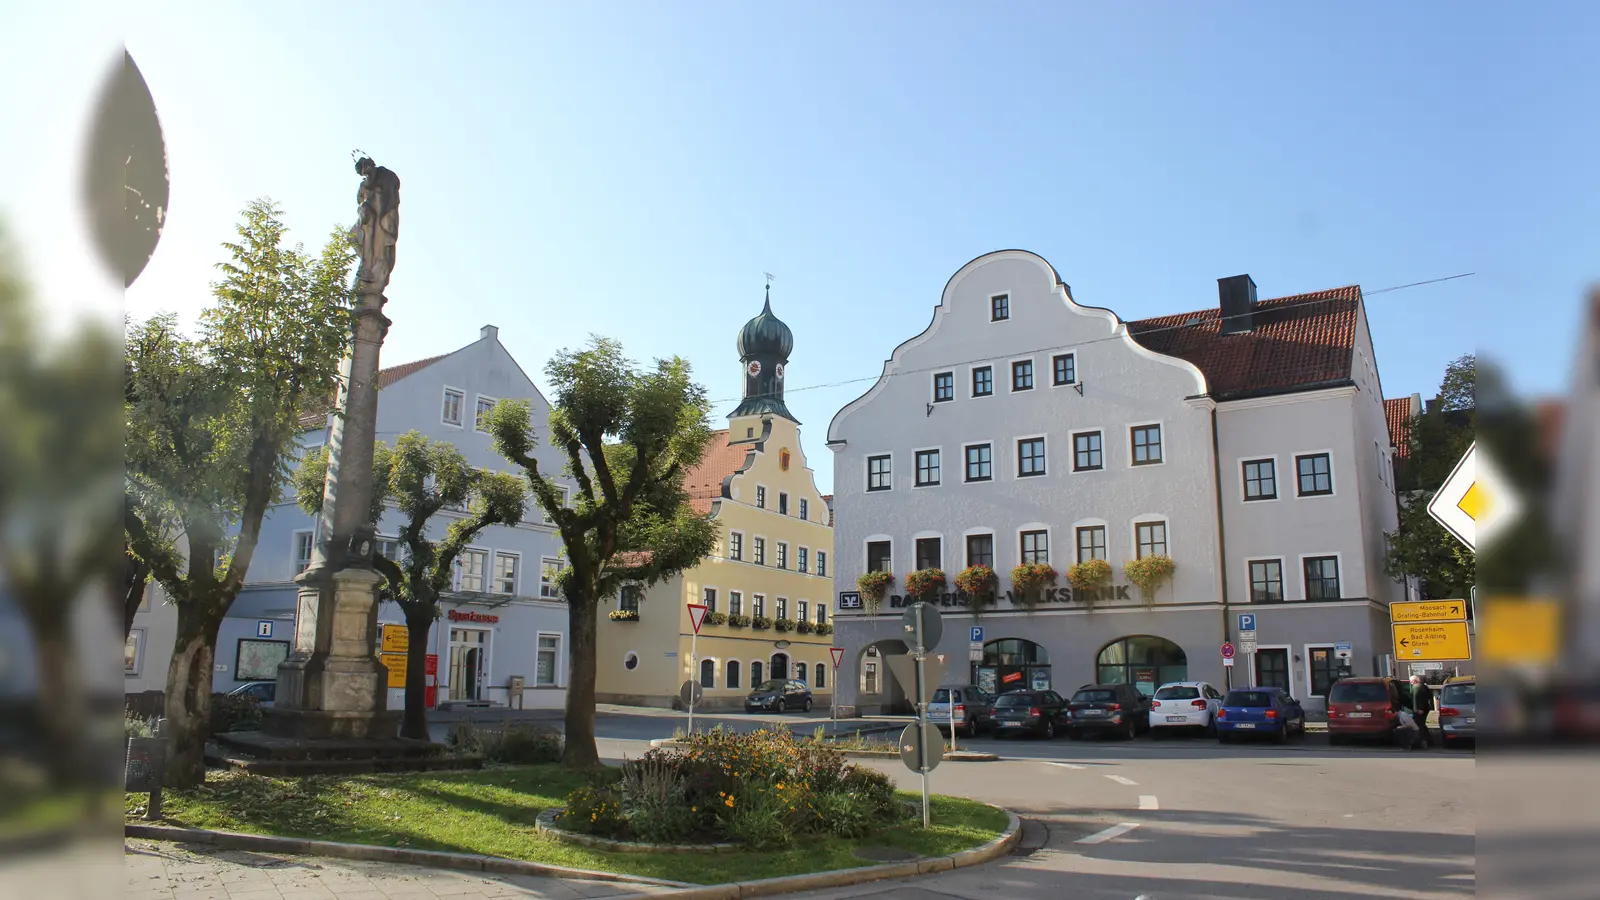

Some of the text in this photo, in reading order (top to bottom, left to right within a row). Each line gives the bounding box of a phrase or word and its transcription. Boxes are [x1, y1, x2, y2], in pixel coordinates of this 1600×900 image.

[448, 610, 499, 623] Sparkasse
[1242, 616, 1252, 629] P
[973, 628, 981, 640] P
